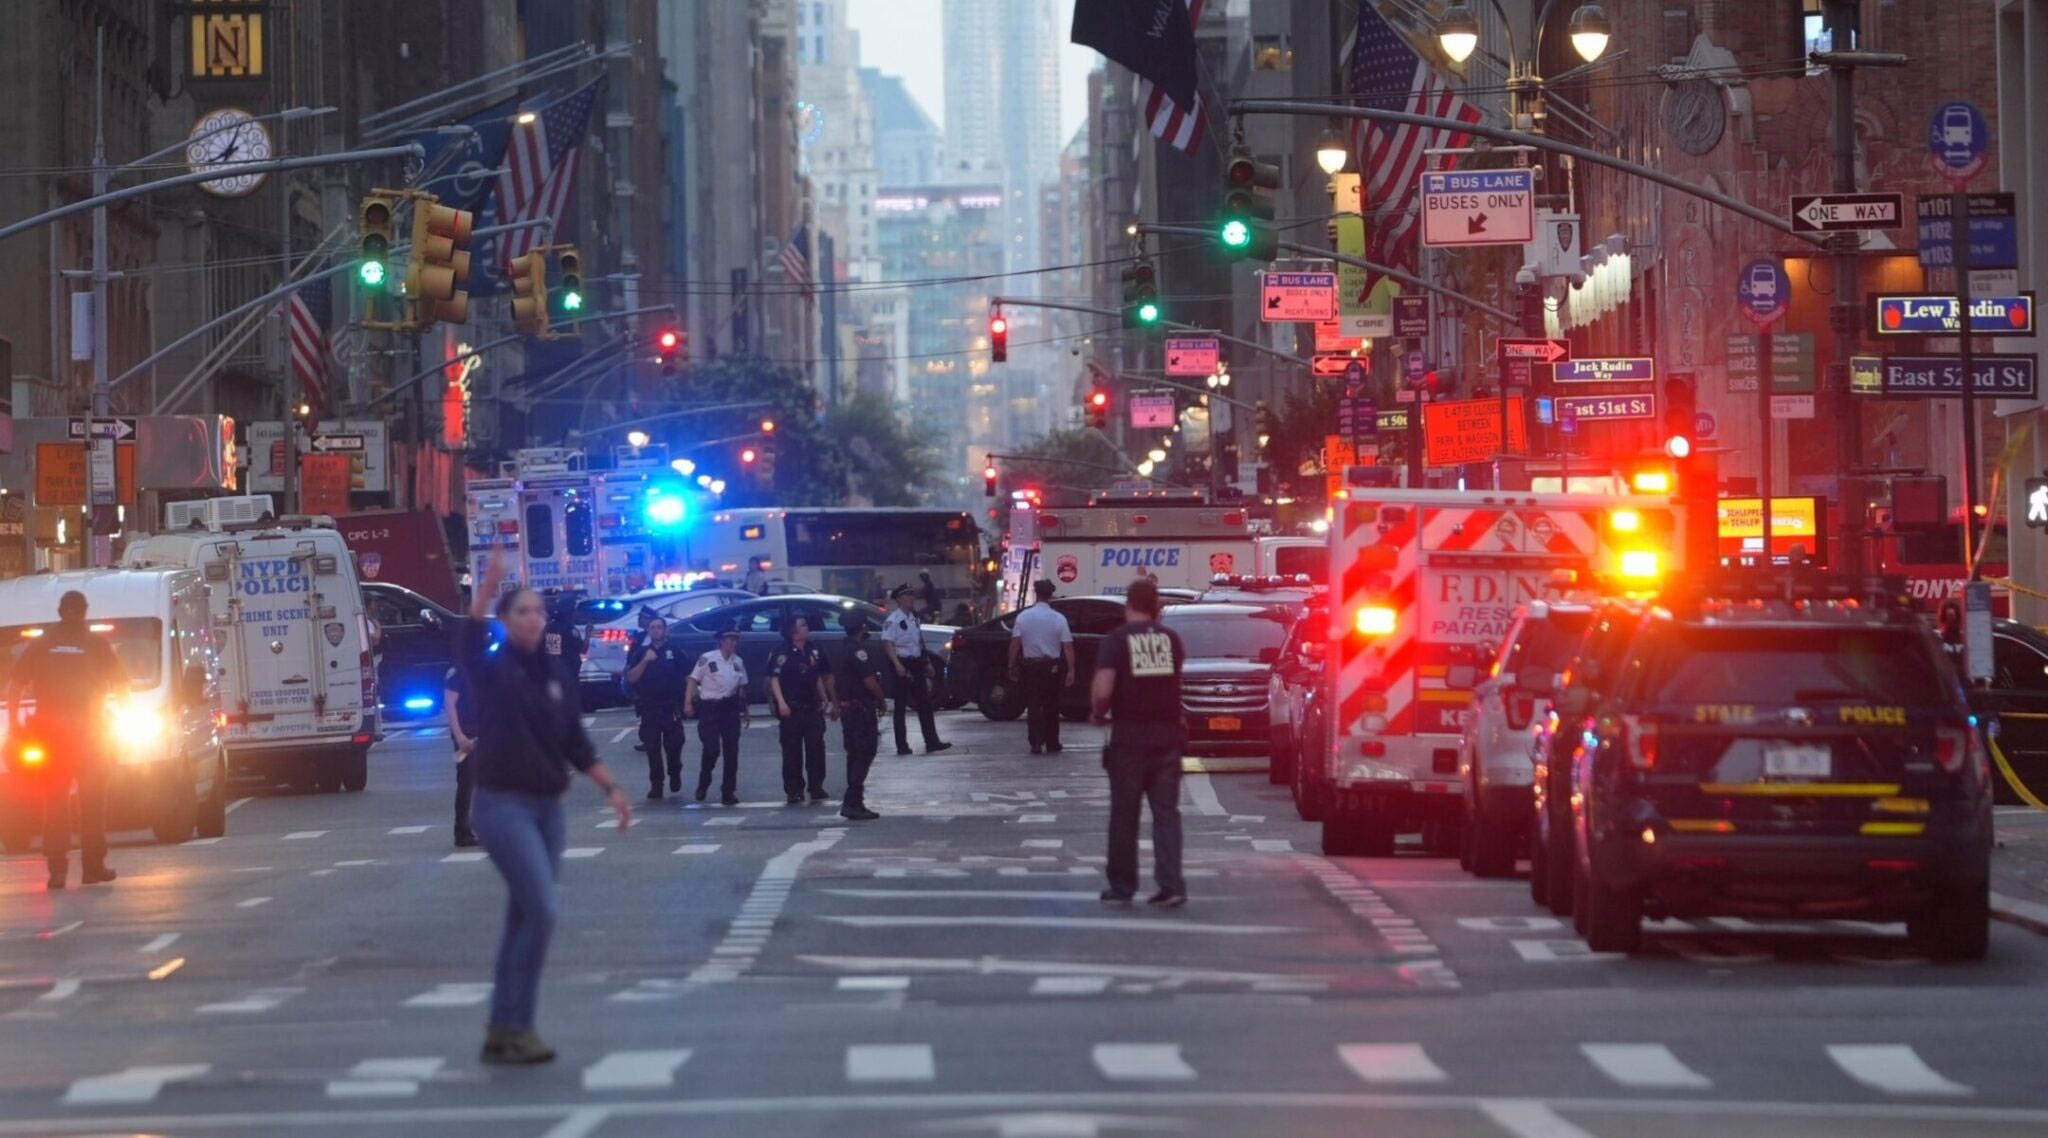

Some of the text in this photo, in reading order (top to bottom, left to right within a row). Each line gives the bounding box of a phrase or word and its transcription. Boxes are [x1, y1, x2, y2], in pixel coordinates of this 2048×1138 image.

[213, 26, 240, 64] N
[1451, 175, 1523, 188] BUS LANE
[1428, 194, 1524, 210] BUSES ONLY
[1808, 204, 1888, 221] ONE WAY
[1281, 276, 1330, 285] BUS LANE
[1903, 301, 1944, 317] Lew
[1356, 320, 1384, 328] CBRE
[1942, 317, 1961, 329] Wa
[1505, 345, 1555, 355] ONE WAY
[1574, 361, 1632, 374] Jack Rudin
[1594, 372, 1613, 380] Way
[1888, 366, 1936, 386] East
[2002, 367, 2025, 387] St
[1598, 402, 1627, 416] 51st
[1631, 400, 1646, 413] St
[1391, 415, 1408, 427] 50t
[1457, 419, 1491, 431] BETWEEN
[104, 423, 123, 434] WAY
[348, 530, 390, 540] CPC L-2
[1101, 548, 1180, 567] POLICE
[241, 560, 301, 577] NYPD
[276, 608, 311, 620] SCENE
[262, 625, 288, 637] UNIT
[1128, 632, 1172, 653] NYPD
[1132, 652, 1174, 668] POLICE
[1696, 705, 1906, 724] STATE POLICE
